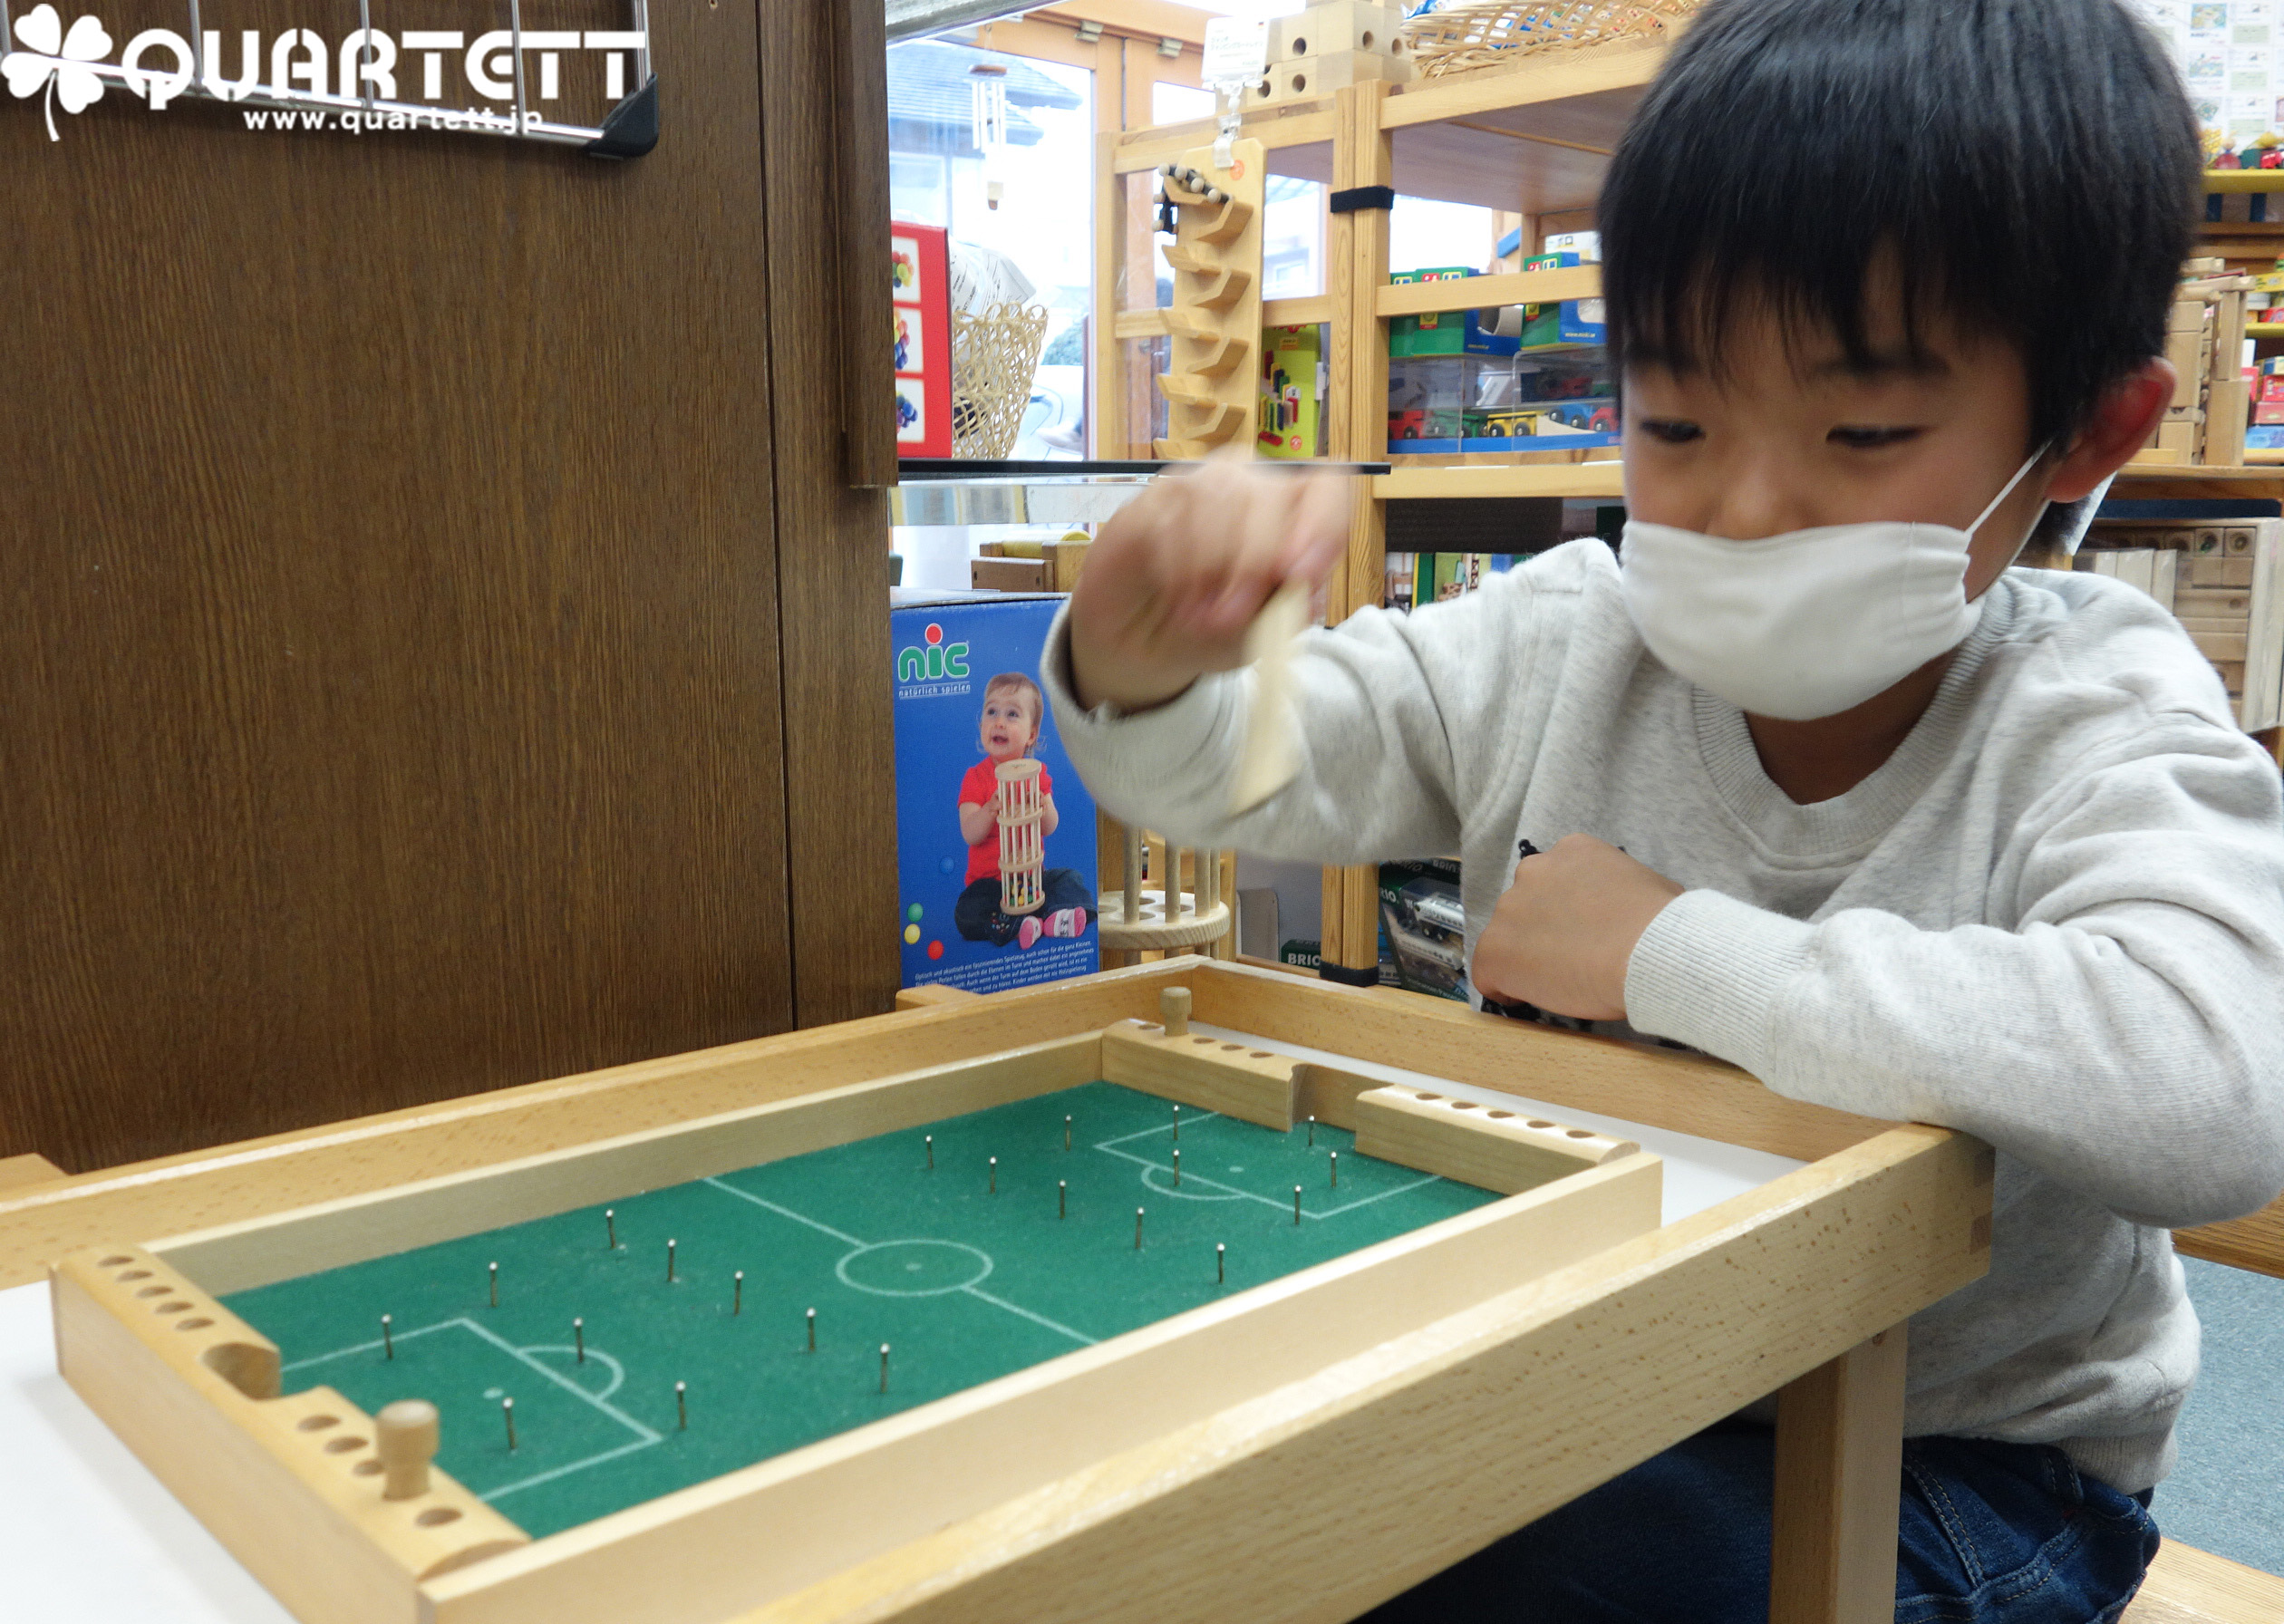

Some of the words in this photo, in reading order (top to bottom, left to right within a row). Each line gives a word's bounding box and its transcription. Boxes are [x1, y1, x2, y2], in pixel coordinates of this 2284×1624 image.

[898, 623, 970, 682] nic
[898, 685, 938, 698] natürlich
[941, 683, 971, 695] spielen
[1288, 952, 1321, 966] BRIO
